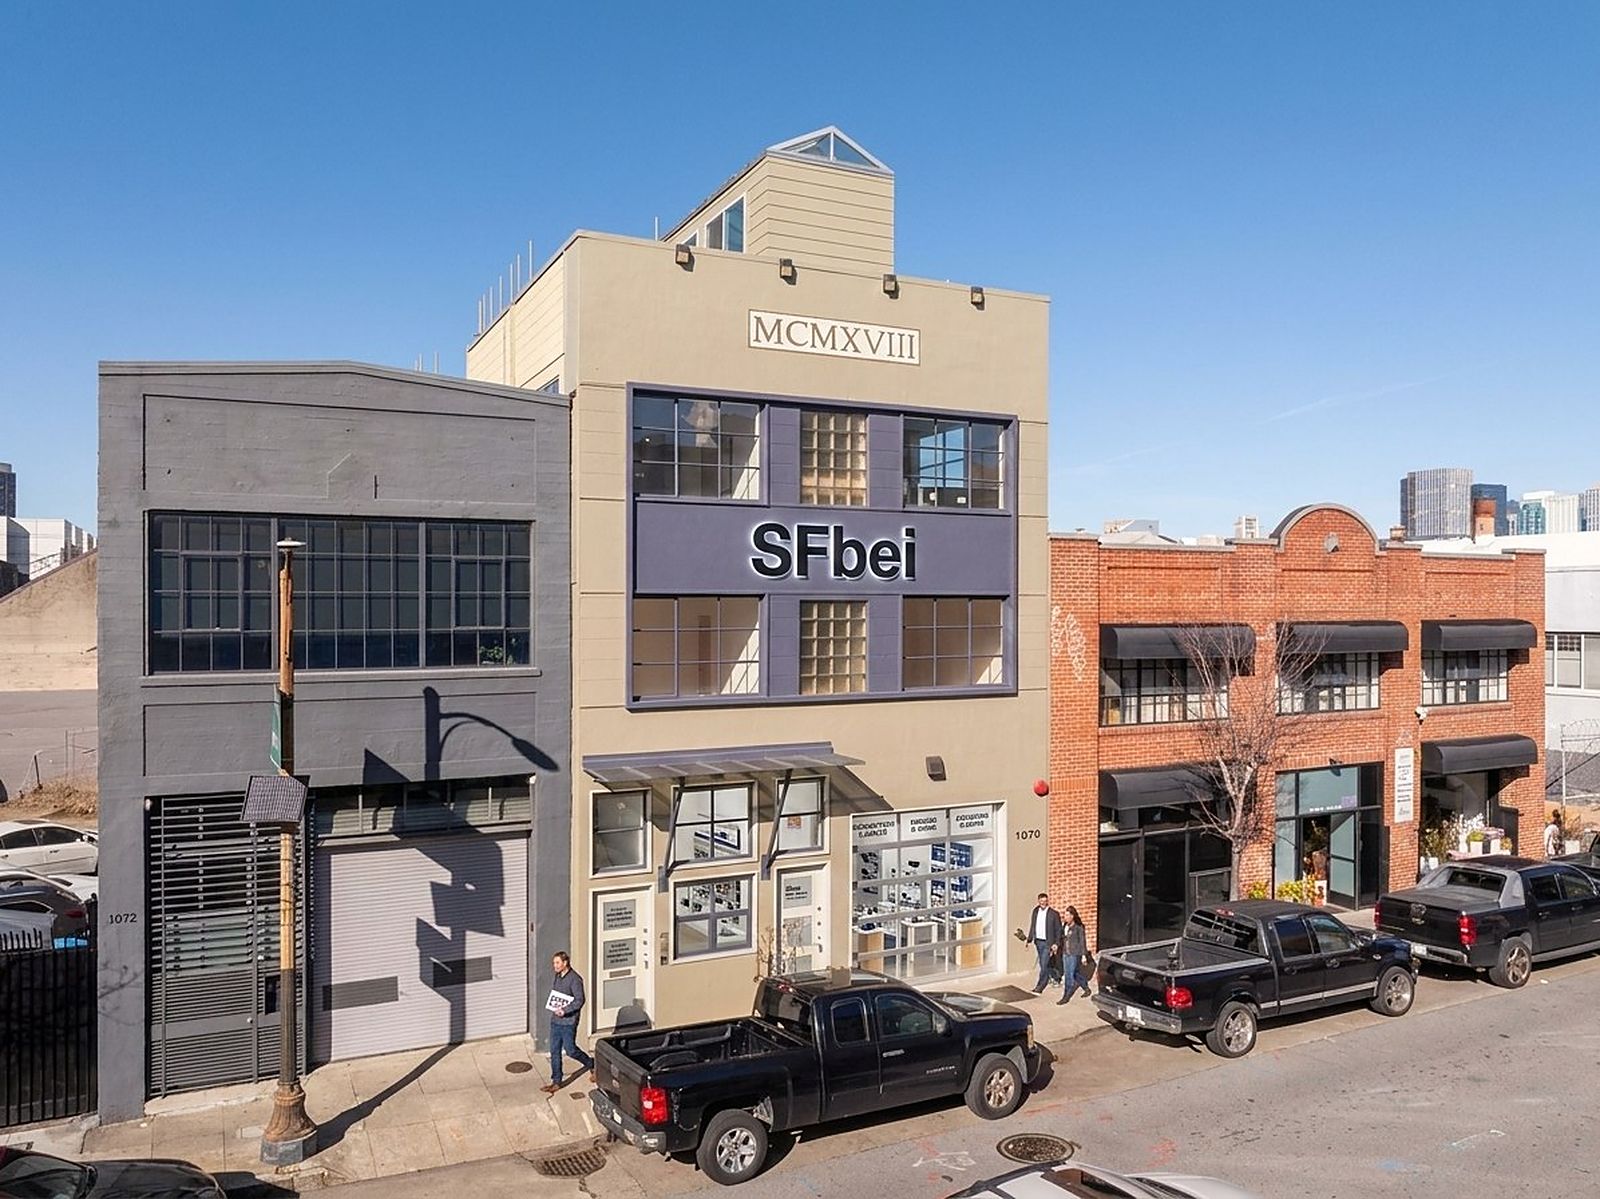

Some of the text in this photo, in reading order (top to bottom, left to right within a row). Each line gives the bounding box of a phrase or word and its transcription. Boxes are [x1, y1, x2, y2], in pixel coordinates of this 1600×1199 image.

[753, 315, 915, 359] MCMXVIII
[750, 522, 916, 580] SFbei
[1015, 829, 1041, 840] 1070
[109, 912, 137, 925] 1072
